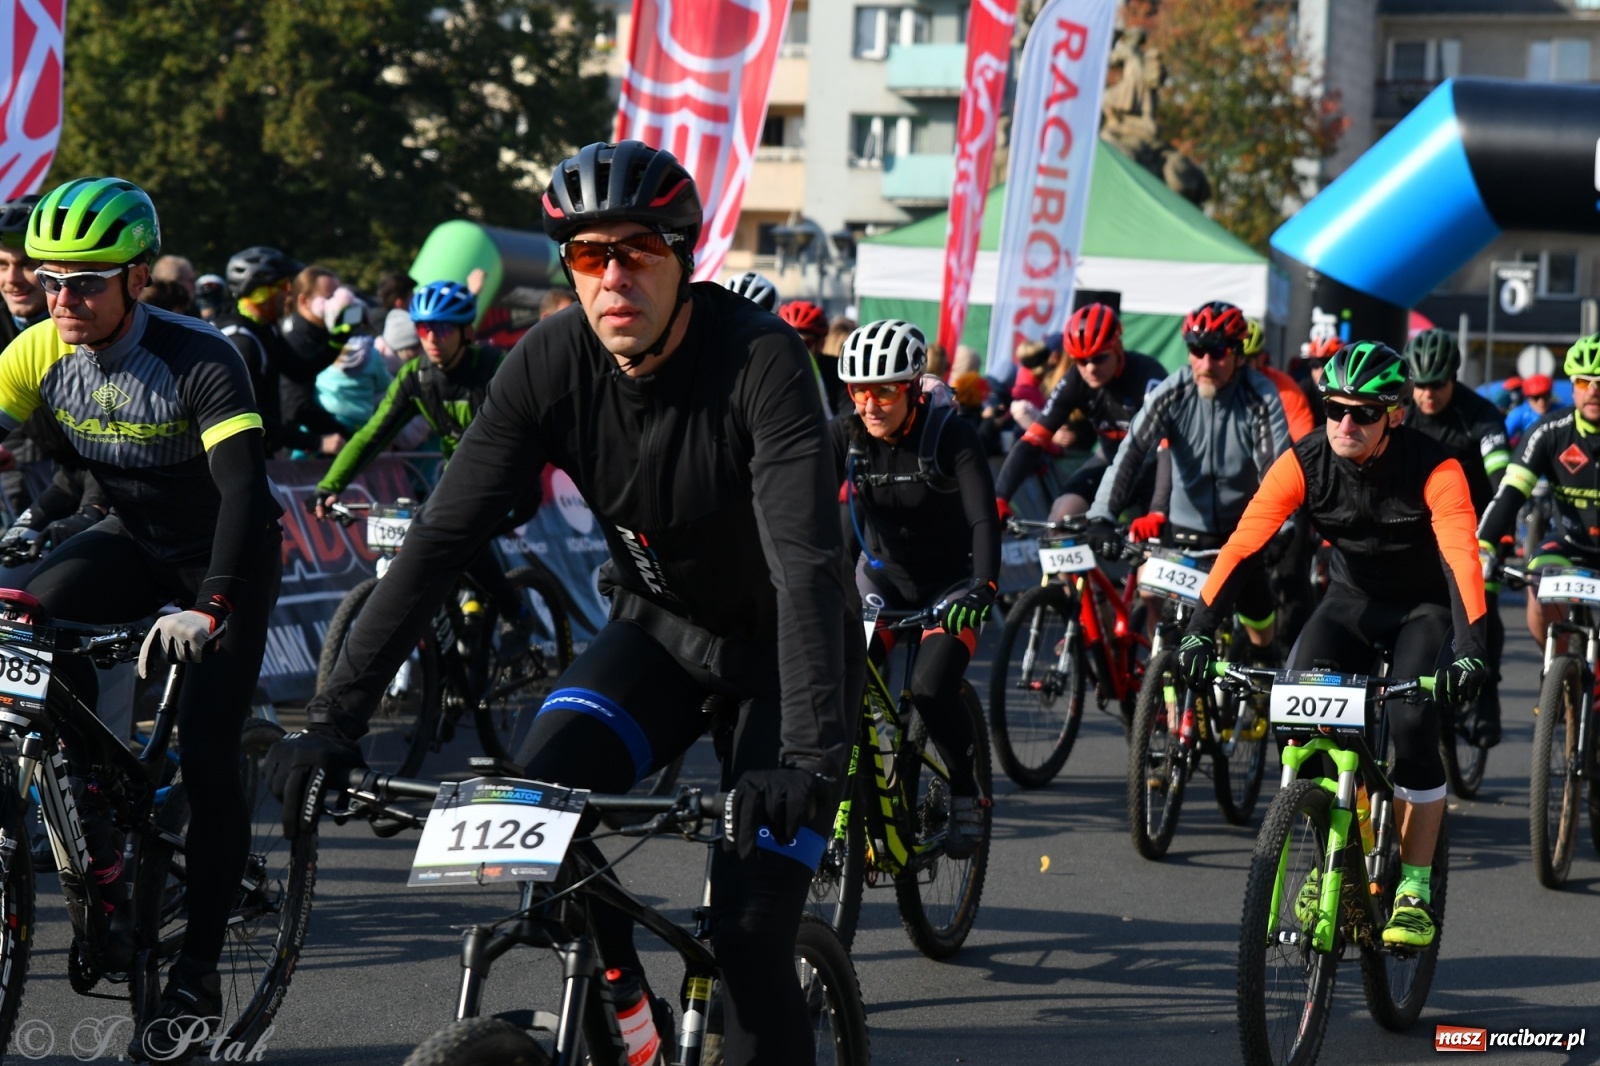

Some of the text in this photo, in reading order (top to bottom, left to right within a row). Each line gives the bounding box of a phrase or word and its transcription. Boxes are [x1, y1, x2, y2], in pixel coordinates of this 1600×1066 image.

[54, 408, 189, 439] BASSO
[615, 525, 662, 594] TWIN
[1050, 551, 1083, 567] 1945
[1156, 567, 1198, 590] 1432
[1553, 582, 1596, 594] 1133
[541, 696, 615, 718] KROSS
[1286, 696, 1348, 718] 2077
[447, 819, 547, 851] 1126
[265, 984, 284, 1015] COBRA
